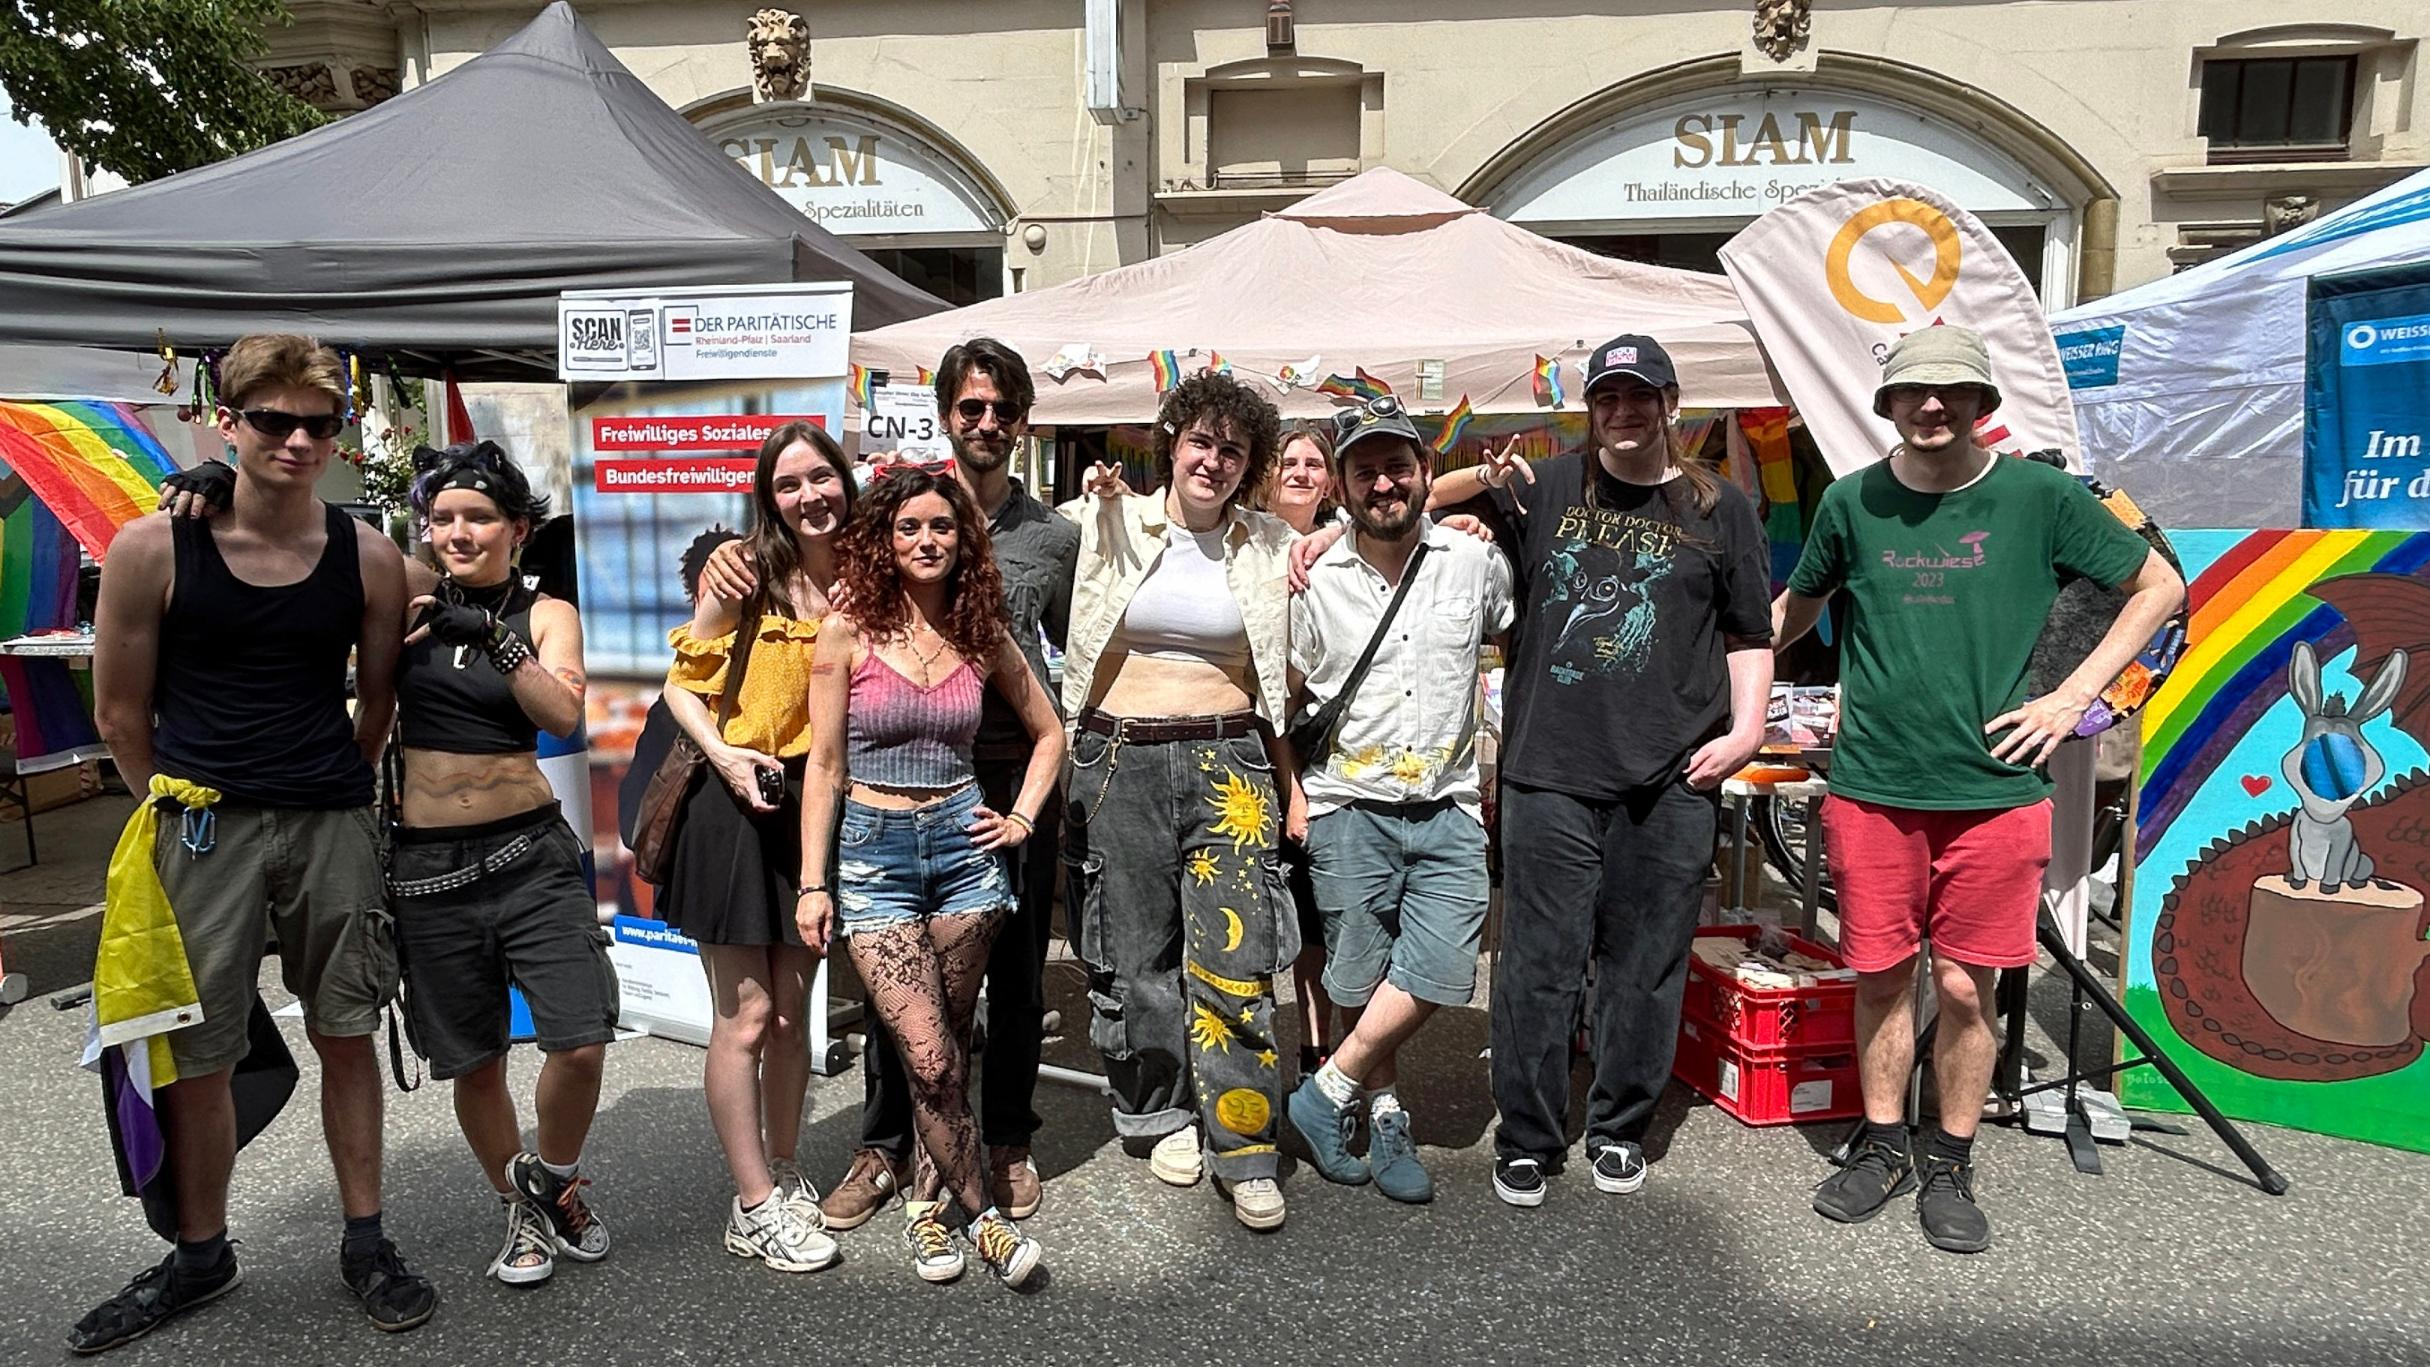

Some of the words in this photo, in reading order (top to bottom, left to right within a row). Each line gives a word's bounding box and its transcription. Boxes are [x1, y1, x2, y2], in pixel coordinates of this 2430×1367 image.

[1673, 110, 1858, 169] SIAM
[1623, 180, 1757, 202] Thailändische
[803, 198, 924, 224] Spezialitäten
[571, 317, 622, 341] SCAN
[695, 317, 724, 332] DER
[728, 312, 837, 331] PARITÄTISCHE
[2380, 324, 2430, 341] WEISS
[576, 334, 620, 351] Here
[695, 334, 763, 345] Rheinland-Pfalz
[770, 334, 812, 344] Saarland
[696, 348, 778, 360] Freiwilligendienste
[600, 424, 698, 446] Freiwilliges
[702, 423, 773, 441] Soziales
[868, 415, 934, 440] CN-3
[2361, 430, 2421, 458] Im
[2335, 469, 2400, 508] für
[1566, 506, 1621, 526] DOCTOR
[1554, 515, 1681, 560] PLEASE
[1912, 572, 1945, 588] 2023
